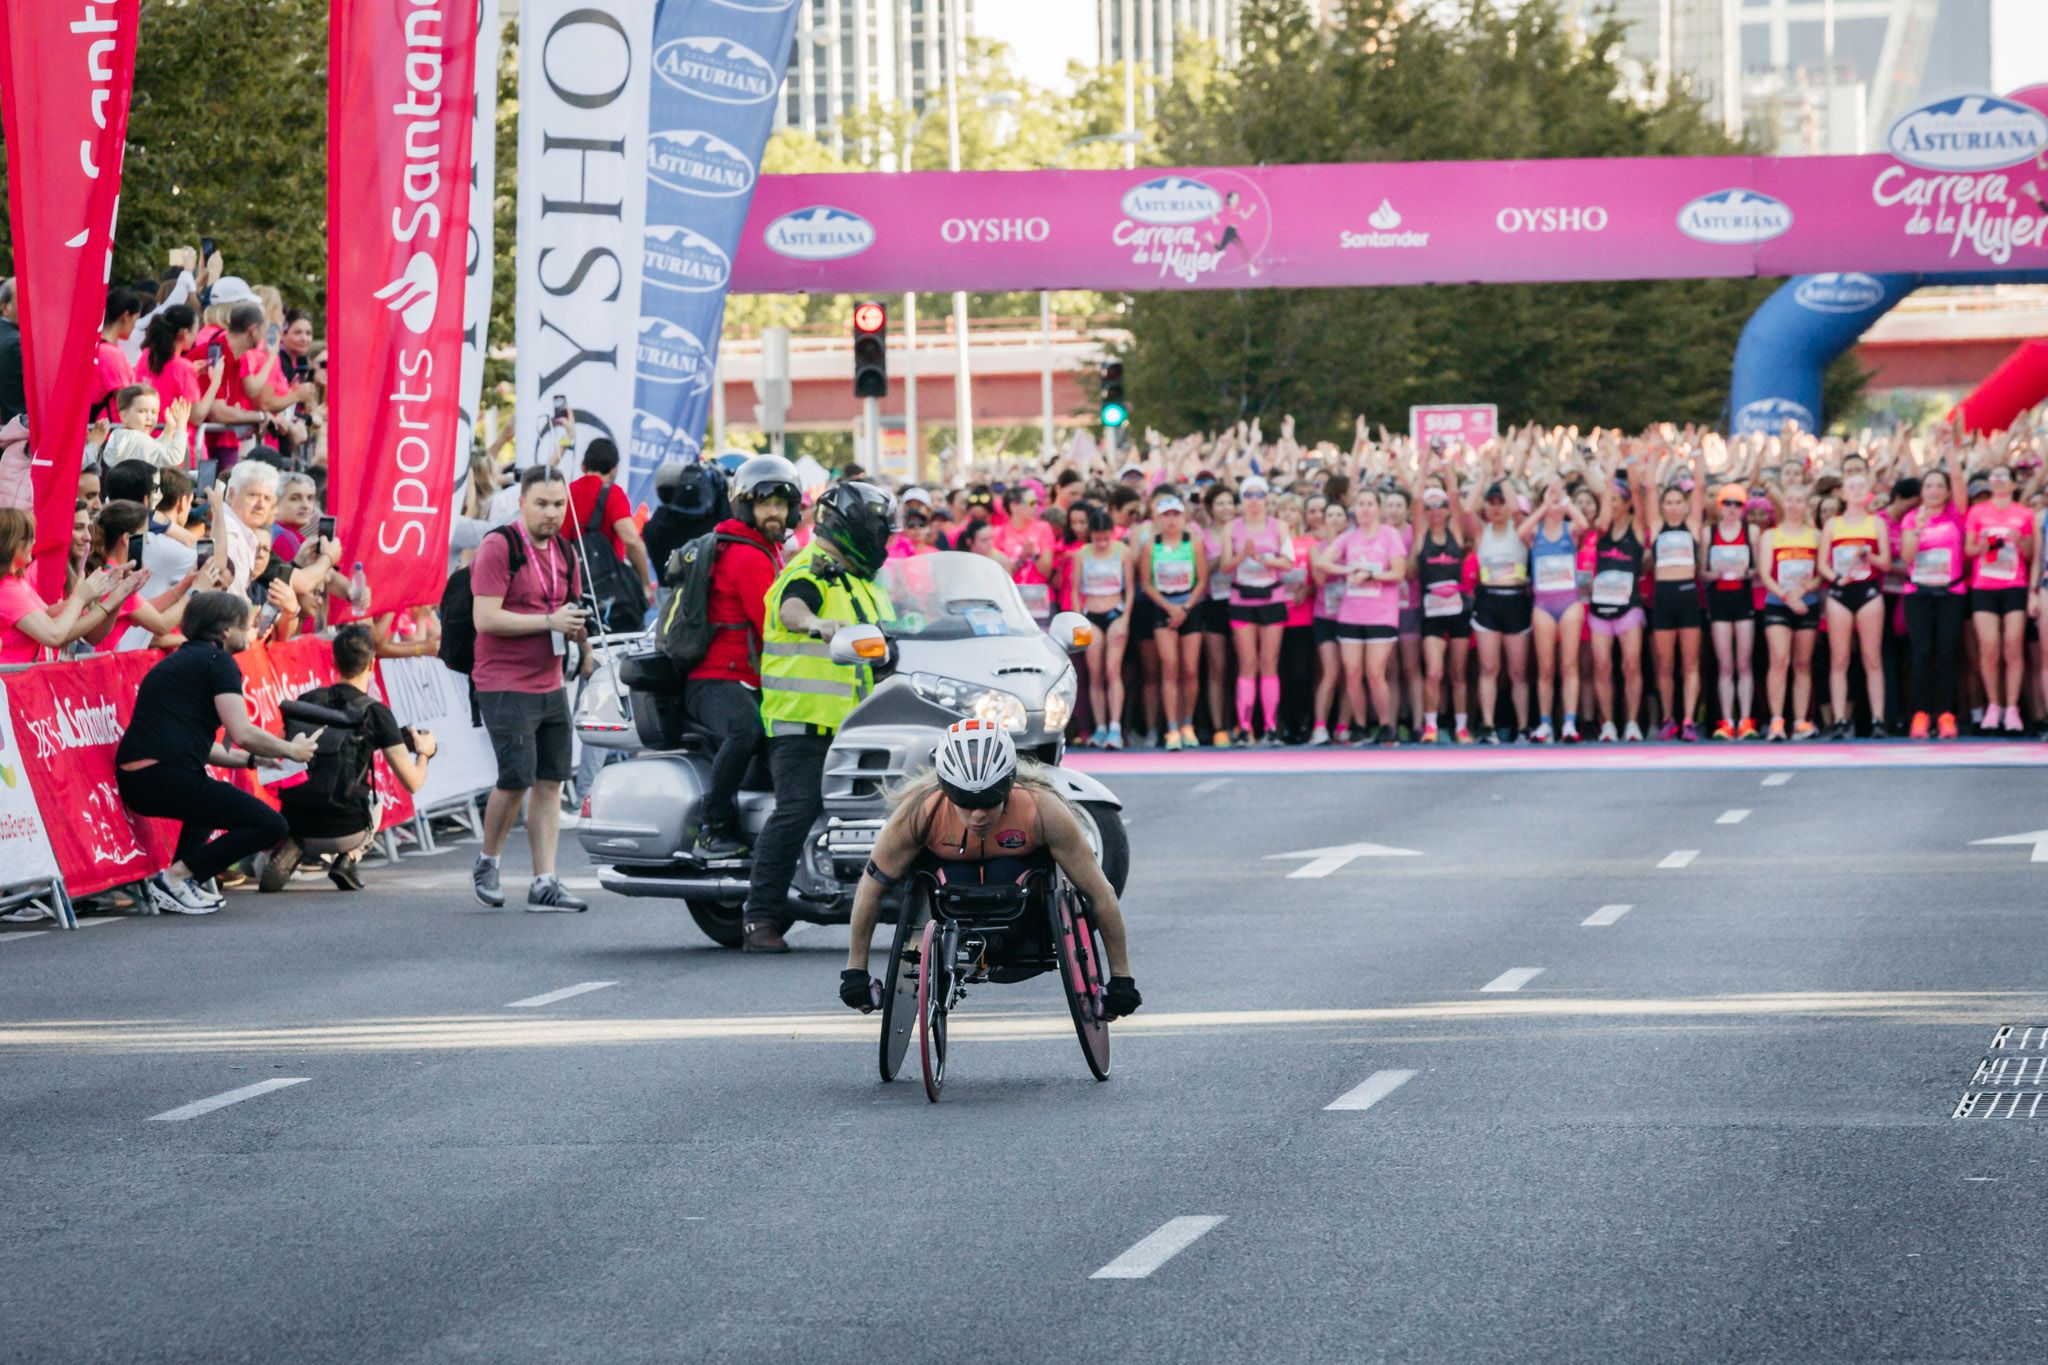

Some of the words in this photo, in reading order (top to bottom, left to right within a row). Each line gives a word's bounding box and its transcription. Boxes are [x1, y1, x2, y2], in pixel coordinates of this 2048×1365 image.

[660, 48, 767, 96] ASTURIANA
[391, 0, 442, 243] Santan
[1903, 124, 2039, 152] ASTURIANA
[1872, 165, 2009, 207] Carrera
[1133, 196, 1214, 212] ASTURIANA
[941, 217, 1050, 243] OYSHO
[1496, 206, 1608, 233] OYSHO
[1688, 211, 1783, 230] ASTURIANA
[1905, 206, 1933, 235] de
[1935, 205, 1955, 234] la
[1949, 197, 2048, 265] Mujer
[775, 227, 866, 246] ASTURIANA
[1112, 220, 1196, 247] Carrera
[1340, 230, 1430, 249] Santander
[1159, 242, 1226, 283] Mujer
[378, 348, 438, 556] Sports
